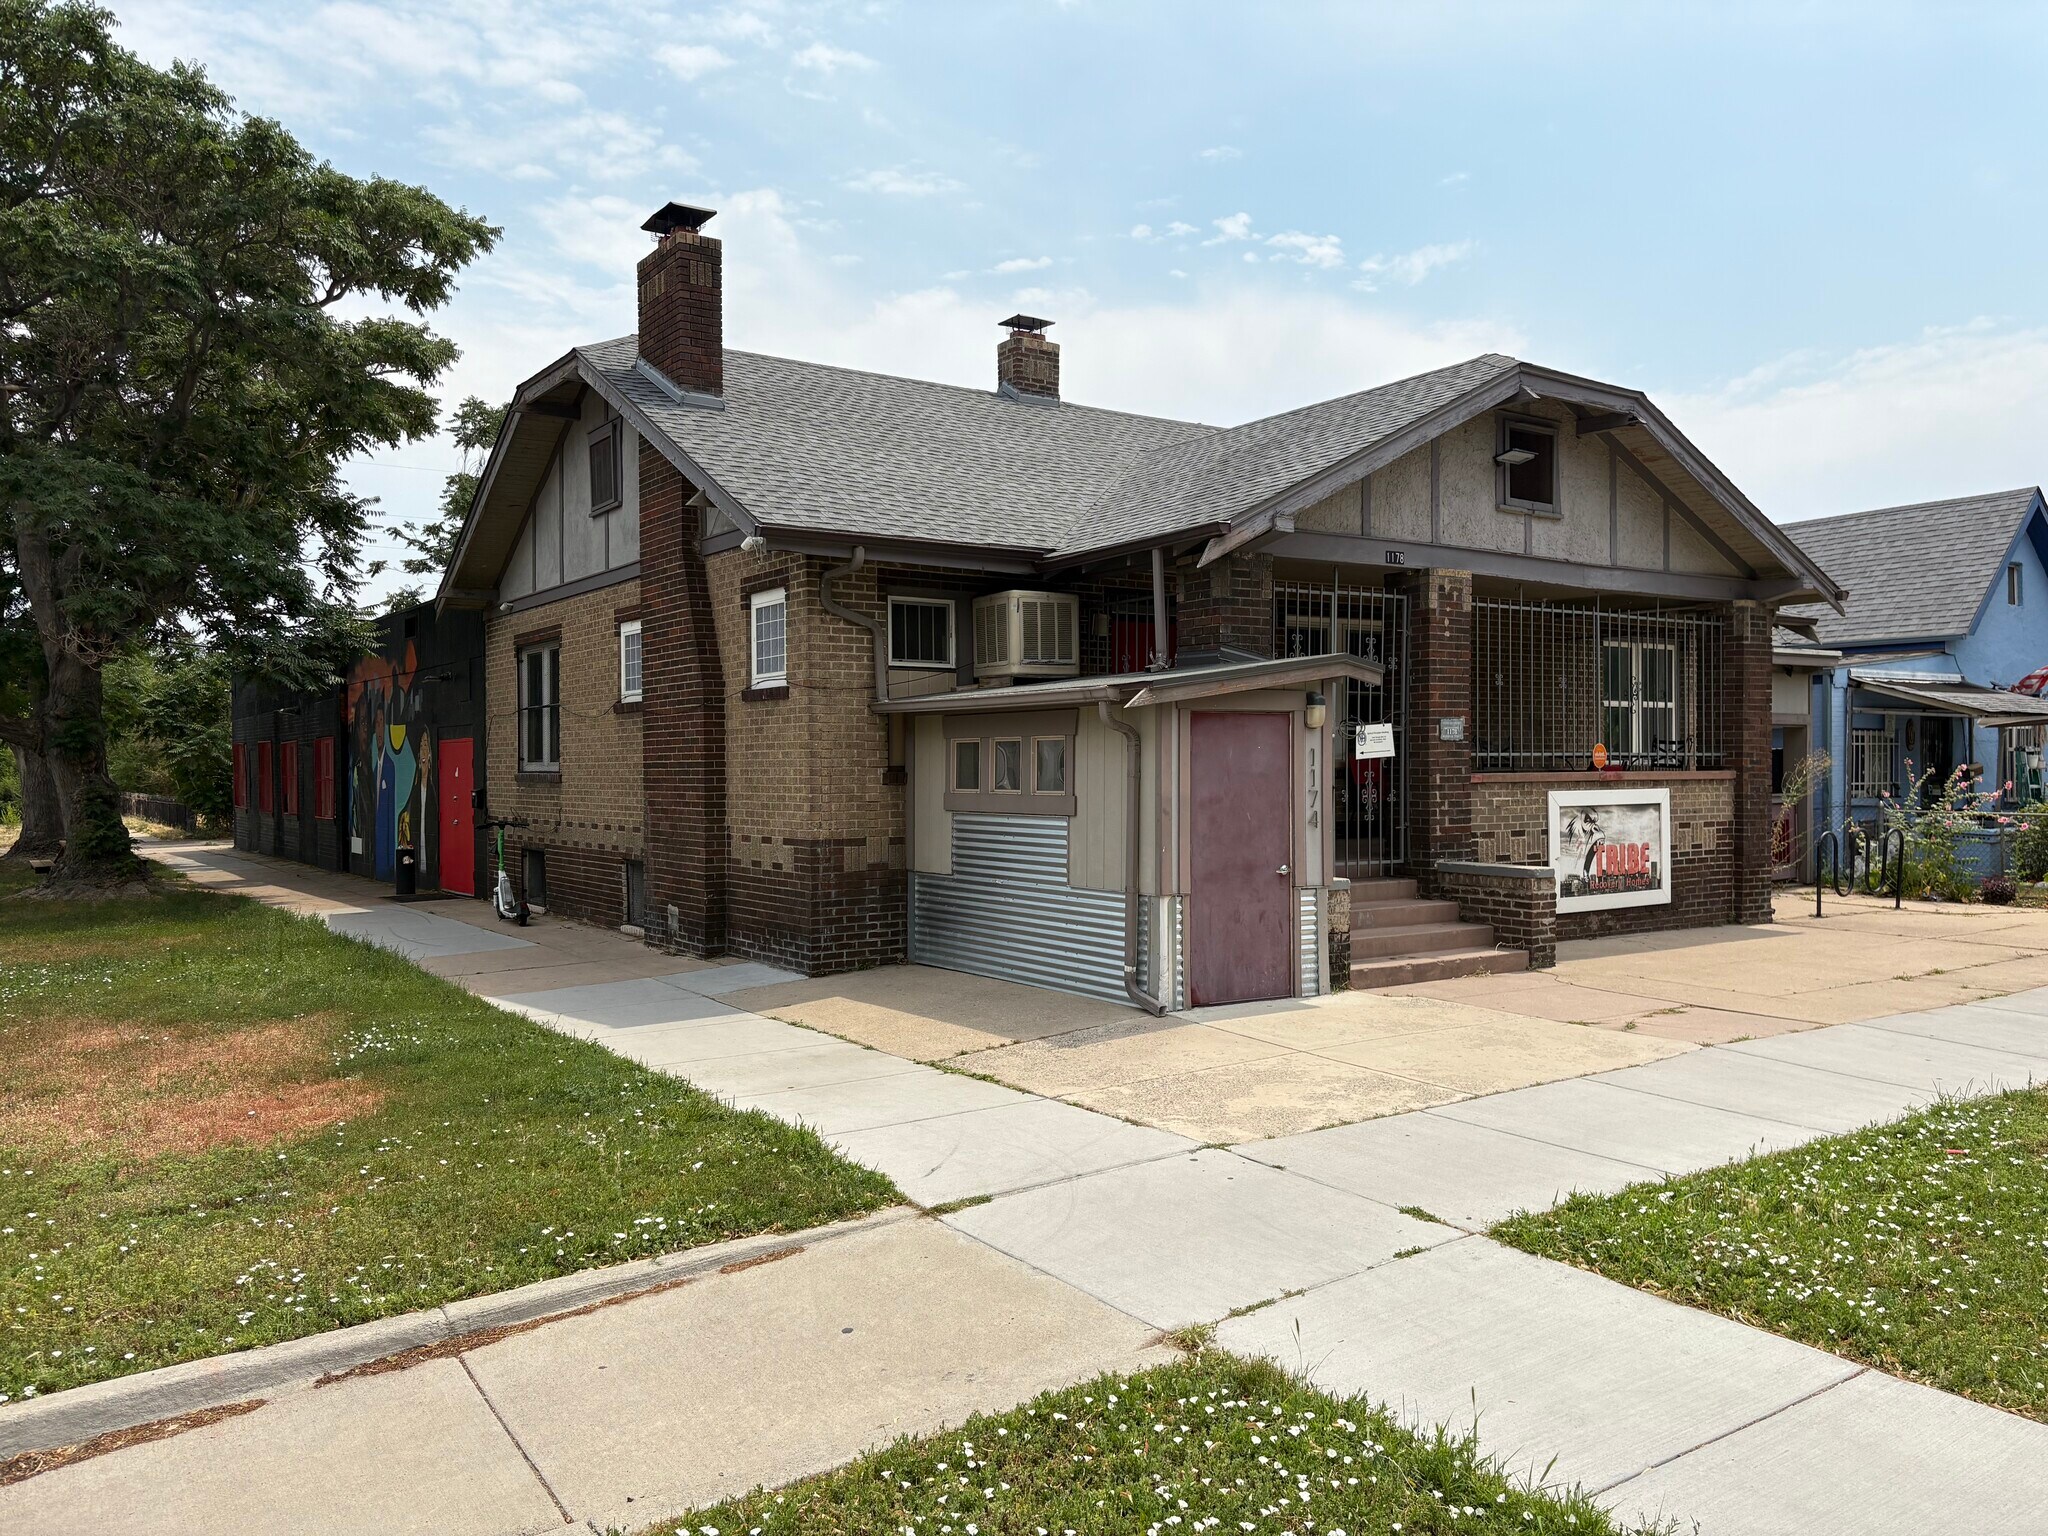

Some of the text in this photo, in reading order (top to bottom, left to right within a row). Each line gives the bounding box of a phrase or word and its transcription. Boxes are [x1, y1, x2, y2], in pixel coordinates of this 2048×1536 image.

[1386, 551, 1404, 564] 1178
[1308, 748, 1319, 829] 1174
[1594, 842, 1650, 877] TRIBE
[1590, 876, 1650, 891] Recovery Homes
